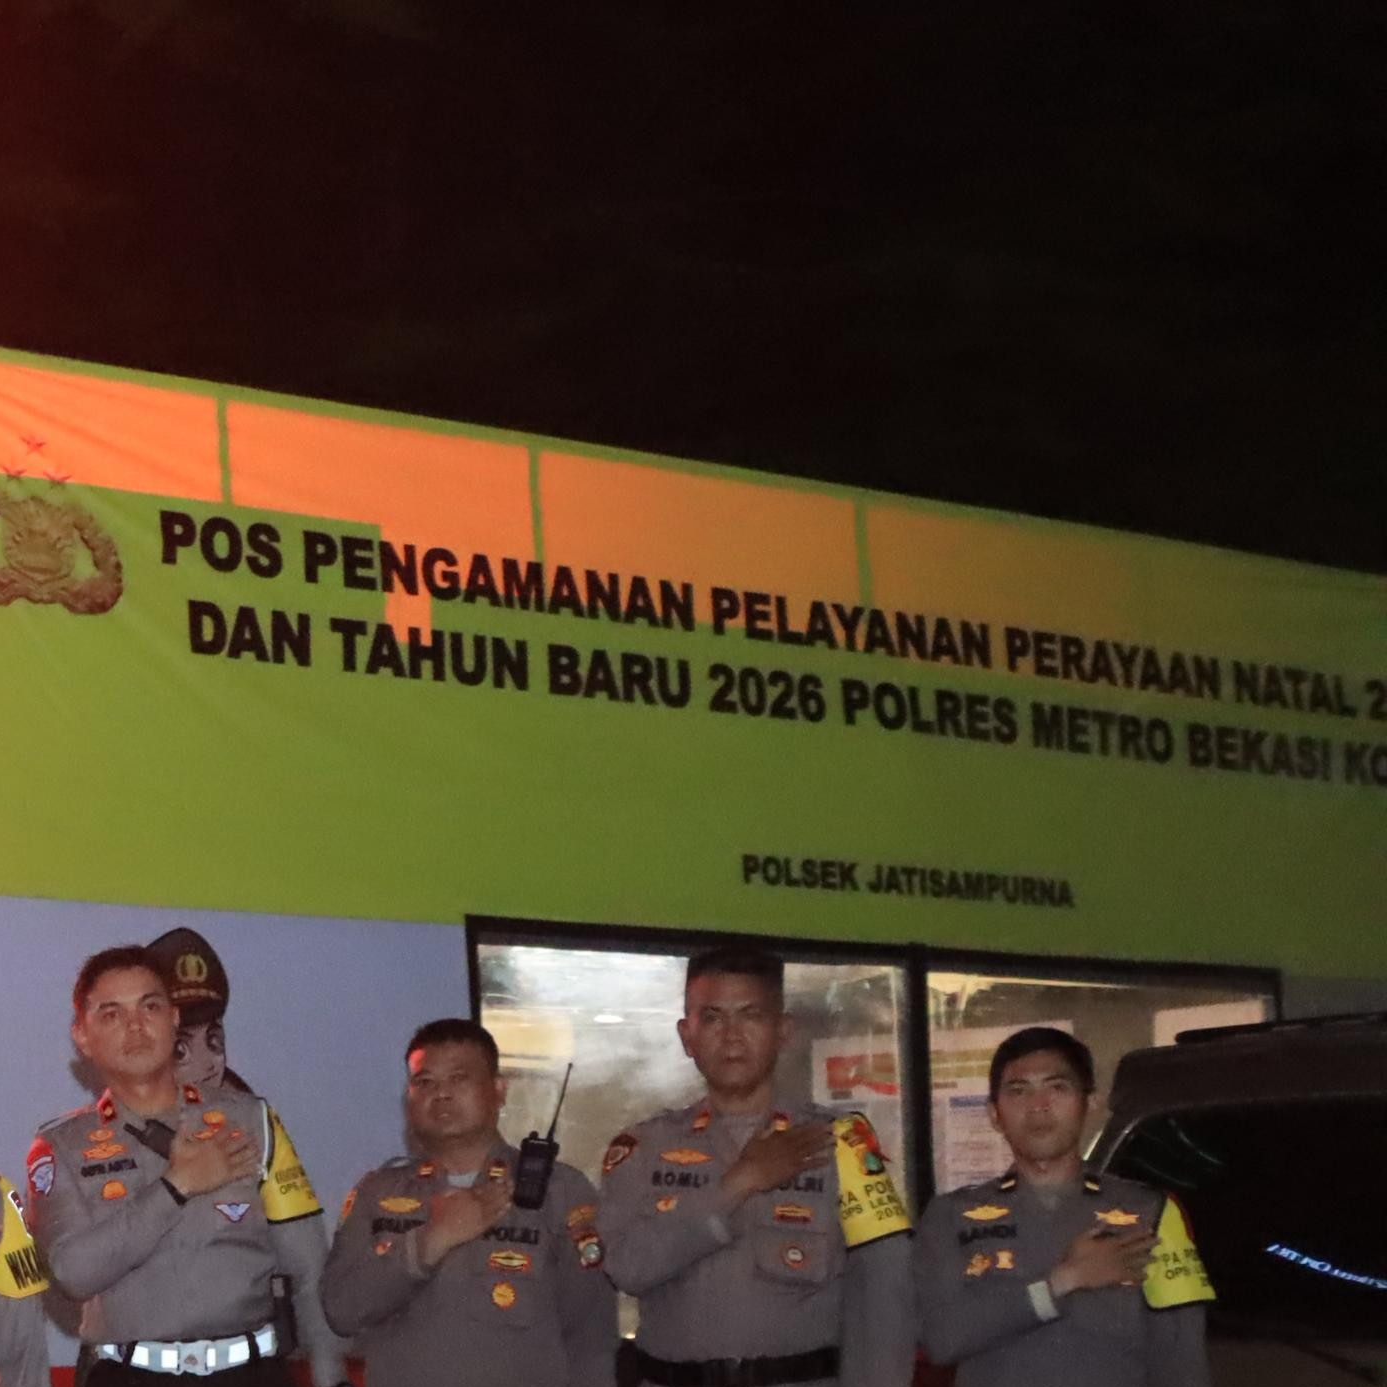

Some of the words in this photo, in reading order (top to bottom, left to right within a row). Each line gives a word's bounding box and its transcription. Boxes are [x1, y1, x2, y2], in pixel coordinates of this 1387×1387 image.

[159, 509, 282, 578] POS
[303, 530, 693, 632] PENGAMANAN
[711, 587, 991, 668] PELAYANAN
[1005, 627, 1221, 699] PERAYAAN
[1233, 661, 1357, 718] NATAL
[187, 600, 311, 667] DAN
[331, 620, 528, 691] TAHUN
[548, 644, 691, 709] BARU
[708, 664, 826, 724] 2026
[841, 679, 1019, 745] POLRES
[1032, 702, 1174, 765] METRO
[1189, 724, 1331, 781] BEKASI
[742, 854, 859, 892] POLSEK
[867, 863, 1075, 909] JATISAMPURNA
